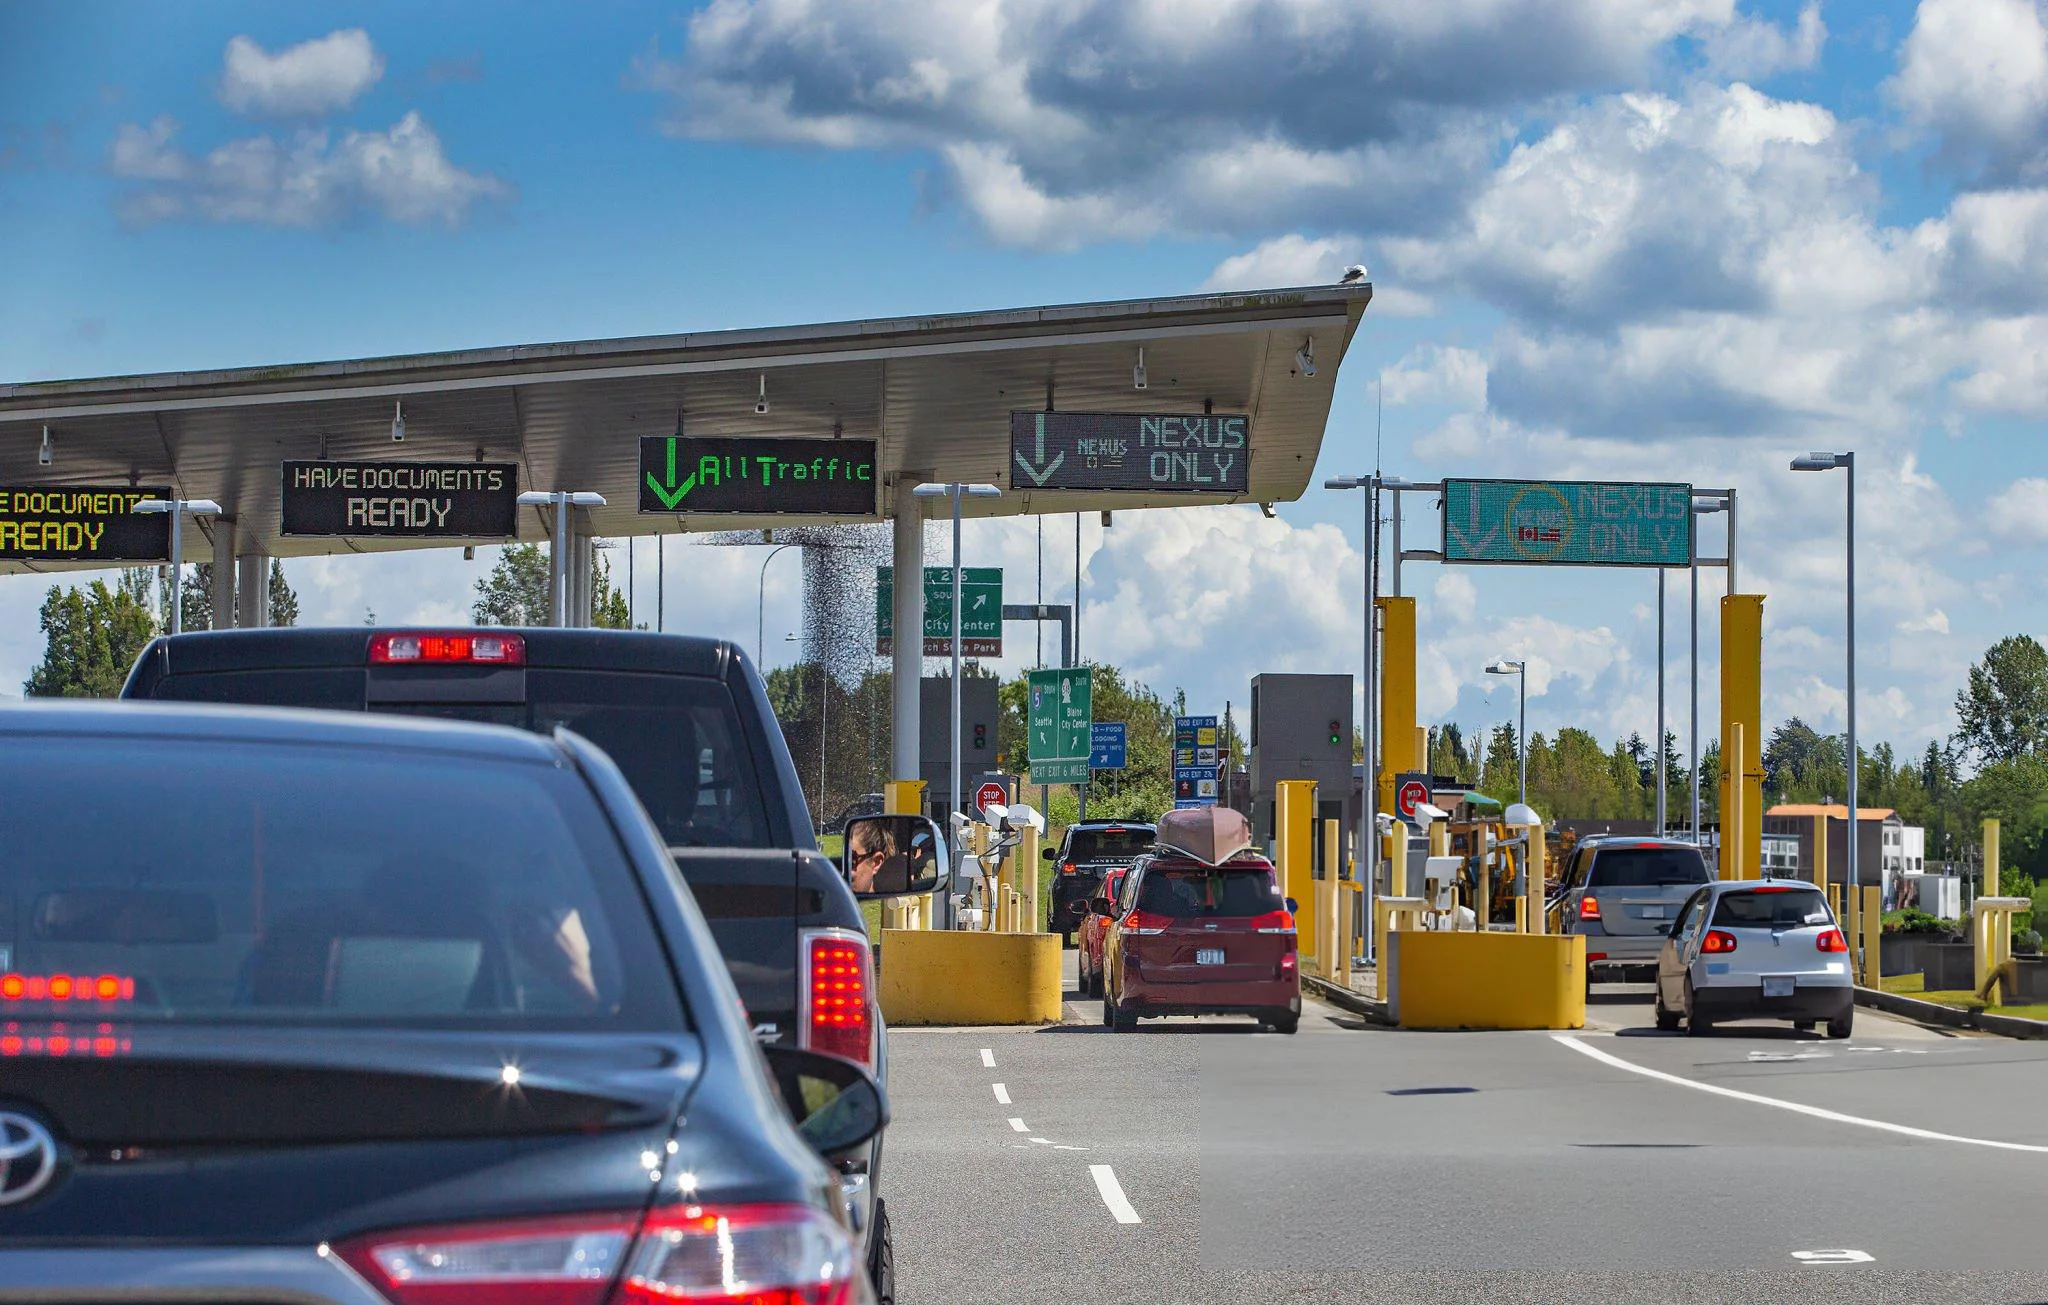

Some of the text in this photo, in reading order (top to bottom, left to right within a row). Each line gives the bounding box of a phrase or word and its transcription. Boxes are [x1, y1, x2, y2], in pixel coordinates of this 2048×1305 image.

[1140, 417, 1244, 449] NEXUS
[1078, 438, 1128, 456] NEXUS
[756, 456, 870, 486] Traffic
[1150, 452, 1233, 483] ONLY
[294, 467, 503, 490] HAVE DOCUMENTS
[1578, 484, 1687, 519] NEXUS
[347, 497, 451, 527] READY
[0, 521, 104, 550] READY
[1589, 523, 1675, 556] ONLY
[941, 570, 968, 581] 26
[925, 619, 995, 632] City enter
[973, 643, 996, 652] Park
[1035, 717, 1052, 726] Seattle
[1072, 719, 1087, 728] Center
[1032, 765, 1087, 777] NEXT EXIT 6 MILES
[983, 791, 1000, 799] STOP
